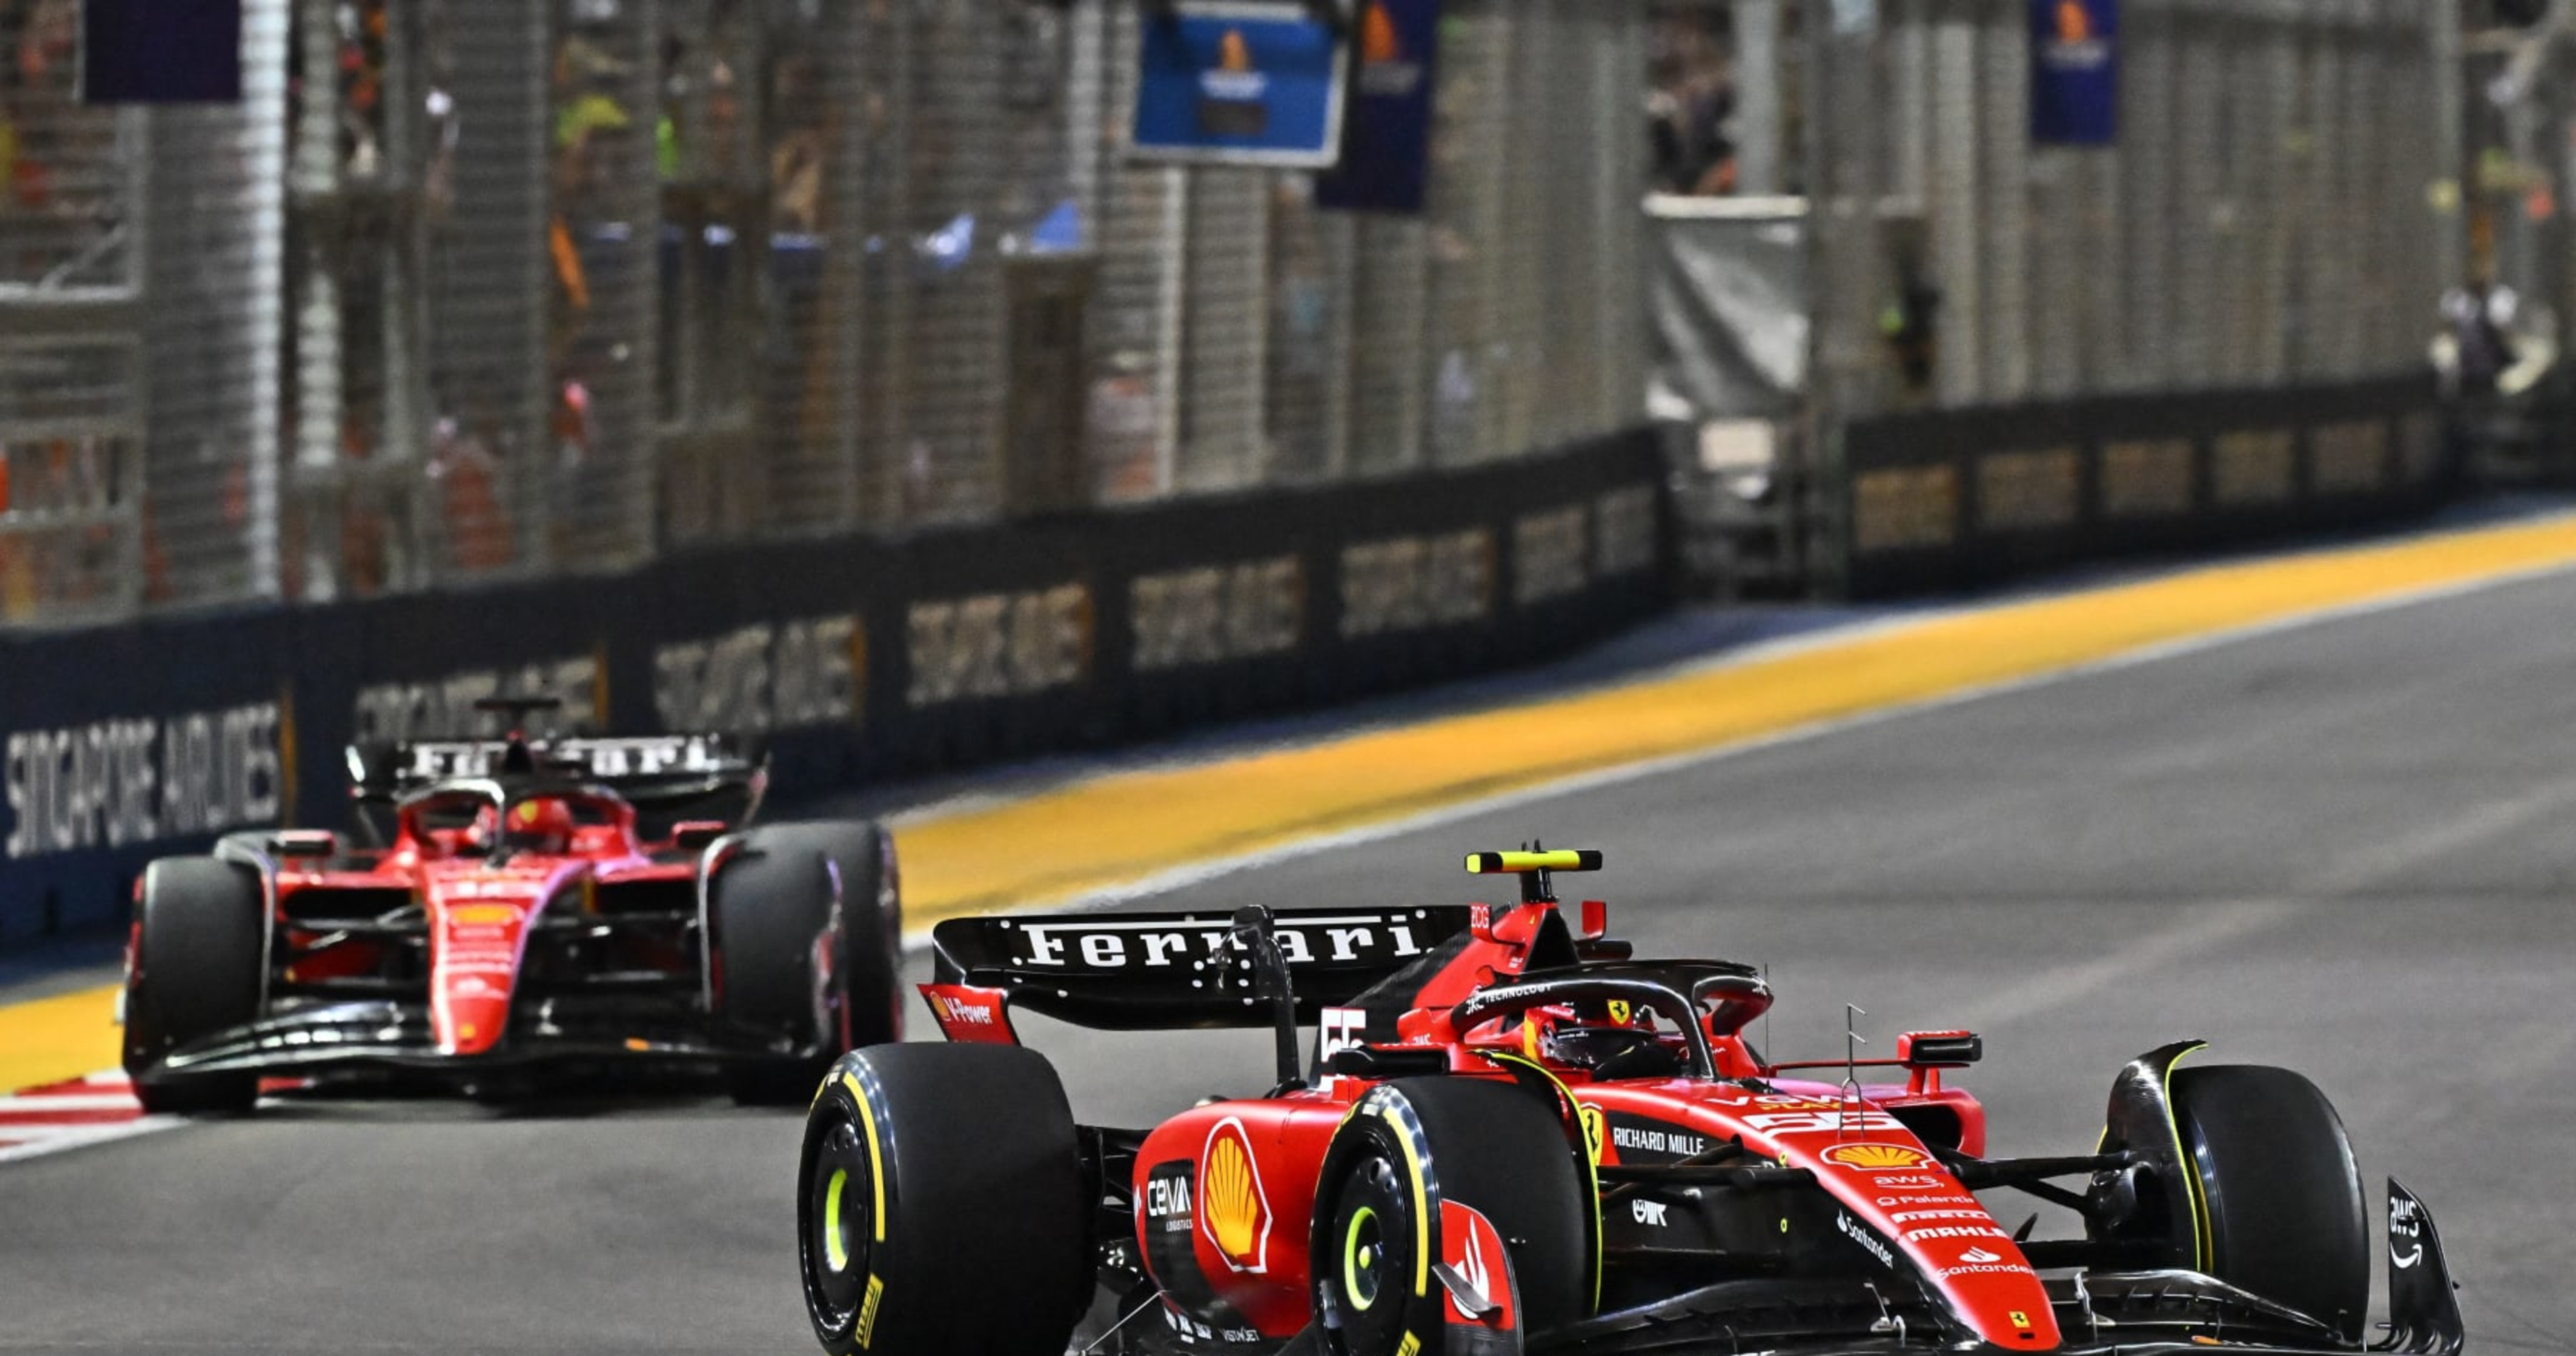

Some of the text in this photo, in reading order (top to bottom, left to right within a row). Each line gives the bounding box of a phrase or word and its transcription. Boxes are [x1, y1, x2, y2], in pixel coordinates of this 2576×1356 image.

[1020, 915, 1422, 968] Ferrari
[1741, 1112, 1909, 1140] 55
[1613, 1128, 1665, 1151] RICHARD
[1873, 1175, 1937, 1184] aws
[1899, 1195, 1975, 1203] Palantir
[1846, 1216, 1893, 1270] Santander
